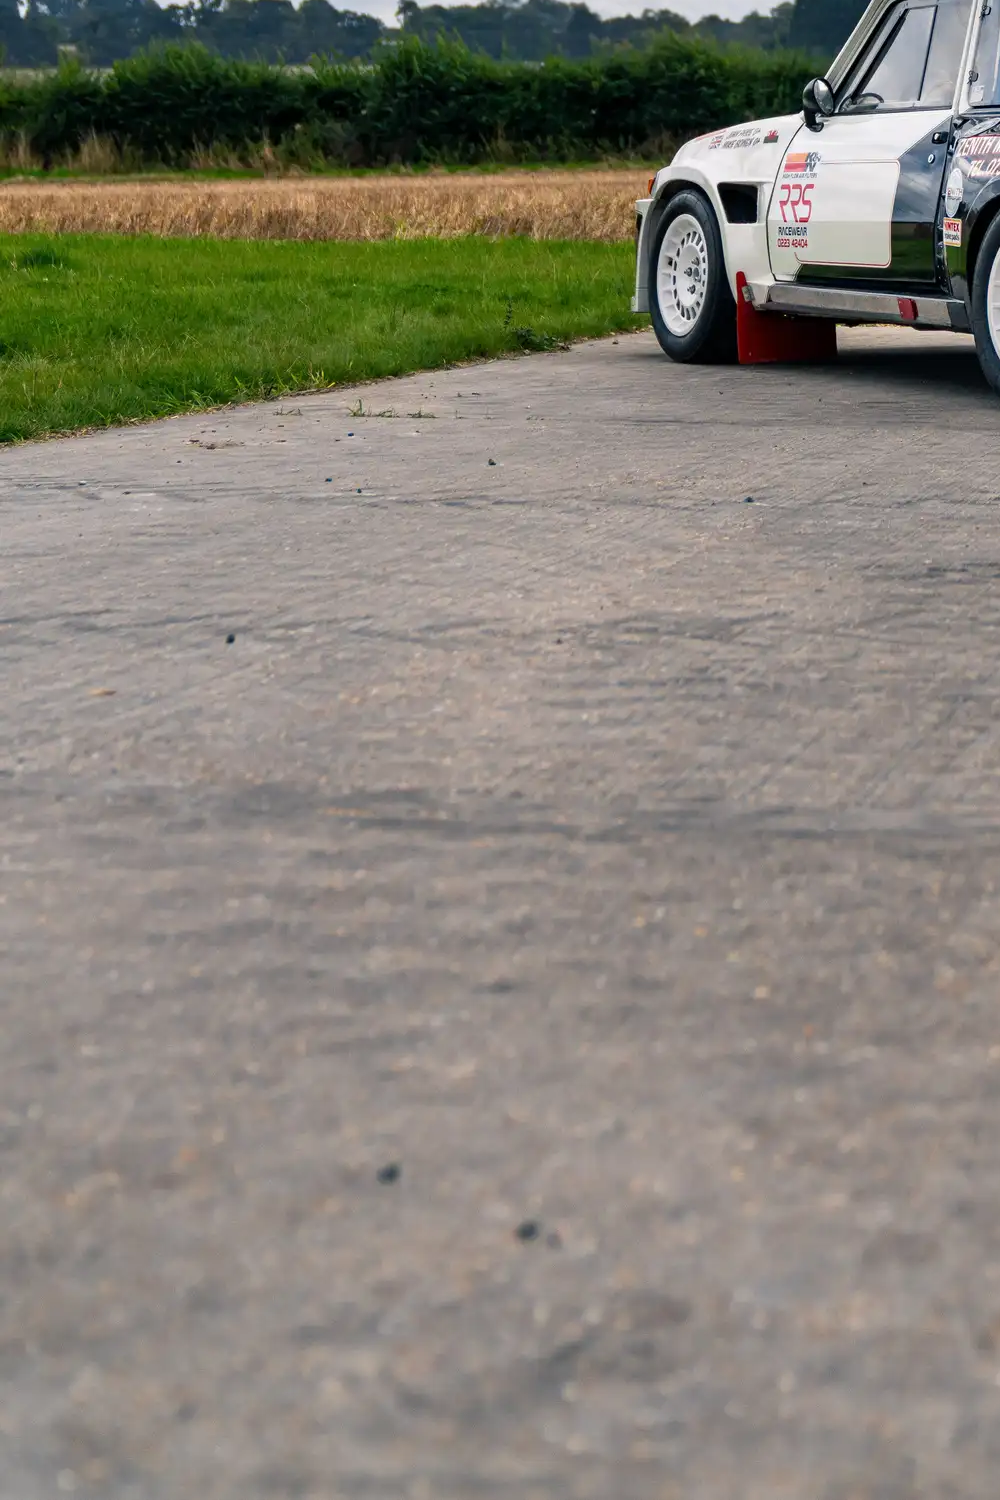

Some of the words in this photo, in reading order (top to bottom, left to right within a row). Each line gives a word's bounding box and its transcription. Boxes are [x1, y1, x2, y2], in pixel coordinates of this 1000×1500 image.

[957, 137, 993, 157] ZENITH
[779, 184, 815, 223] RRS
[778, 226, 808, 237] RACEWEAR
[777, 238, 790, 248] 0223
[791, 238, 808, 248] 42404
